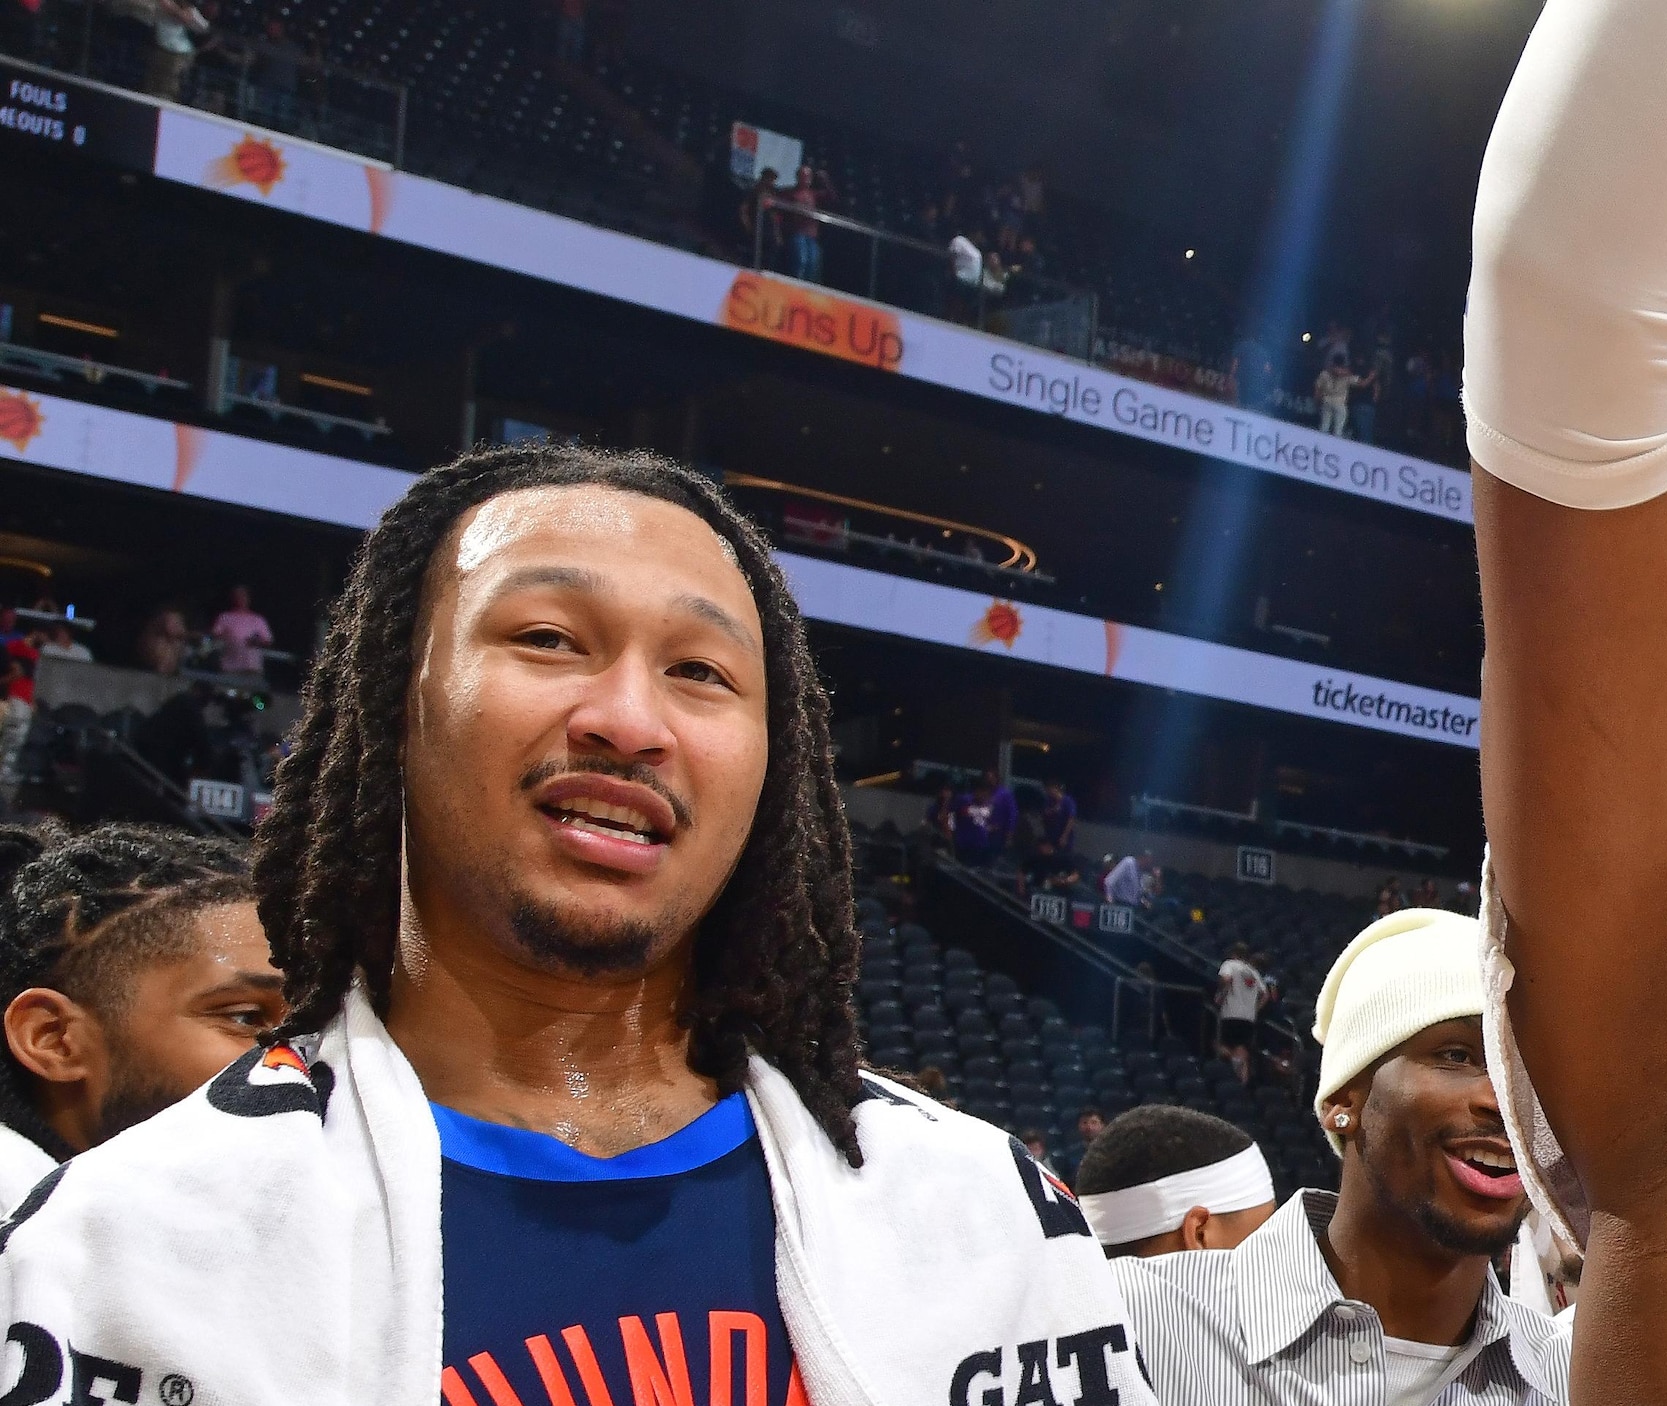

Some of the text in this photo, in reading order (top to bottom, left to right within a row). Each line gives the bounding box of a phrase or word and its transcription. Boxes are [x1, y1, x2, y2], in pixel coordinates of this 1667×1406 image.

[728, 279, 903, 371] Suns Up
[988, 352, 1100, 416] Single
[1112, 386, 1214, 447] Game
[1225, 416, 1340, 480] Tickets
[1350, 460, 1389, 493] on
[1397, 464, 1461, 512] Sale
[1310, 677, 1479, 739] ticketmaster
